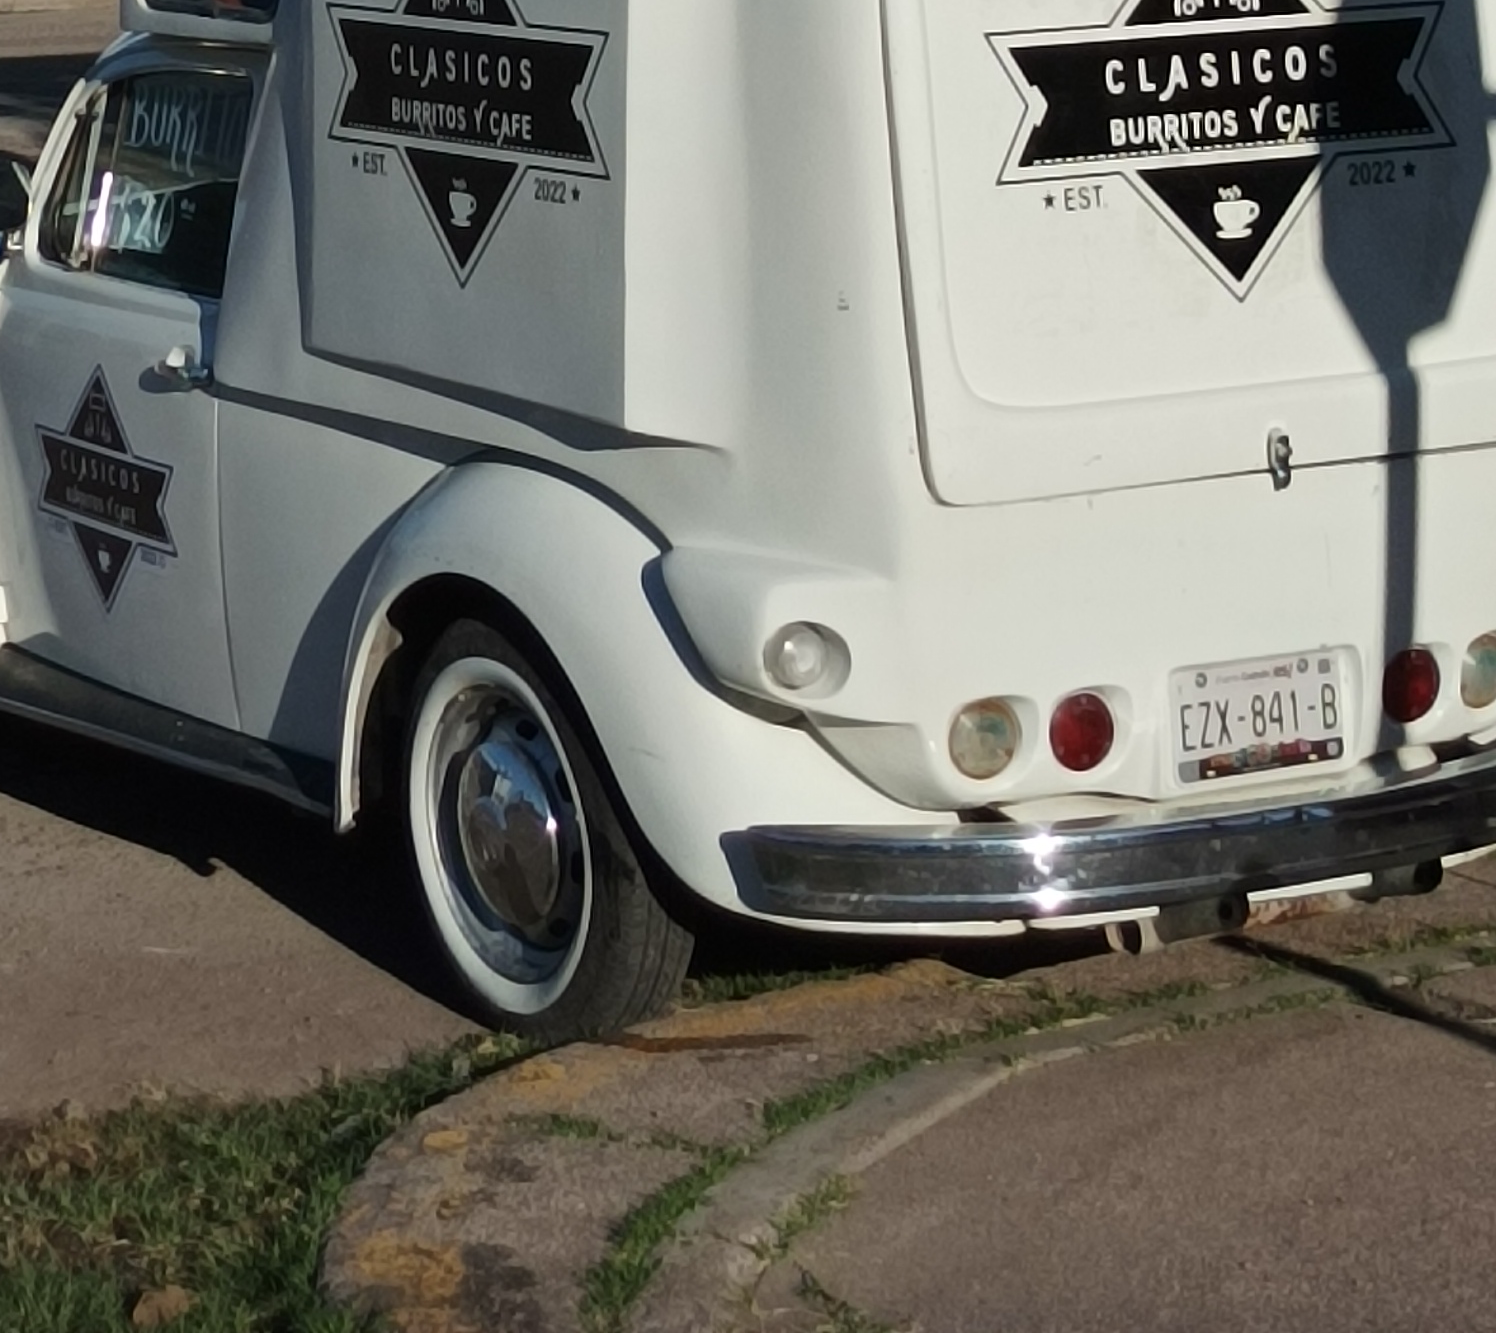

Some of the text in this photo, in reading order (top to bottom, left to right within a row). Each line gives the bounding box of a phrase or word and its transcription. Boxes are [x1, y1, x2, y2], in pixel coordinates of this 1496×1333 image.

[390, 42, 533, 91] CLASICOS
[1104, 44, 1338, 102] CLASICOS
[391, 97, 533, 146] BURRITOS Y CAFE
[1109, 95, 1341, 153] BURRITOS Y CAFE
[533, 177, 567, 205] 2022
[1347, 160, 1396, 187] 2022
[60, 448, 141, 495] CLASICOS
[1179, 682, 1338, 752] EZX-841-B
